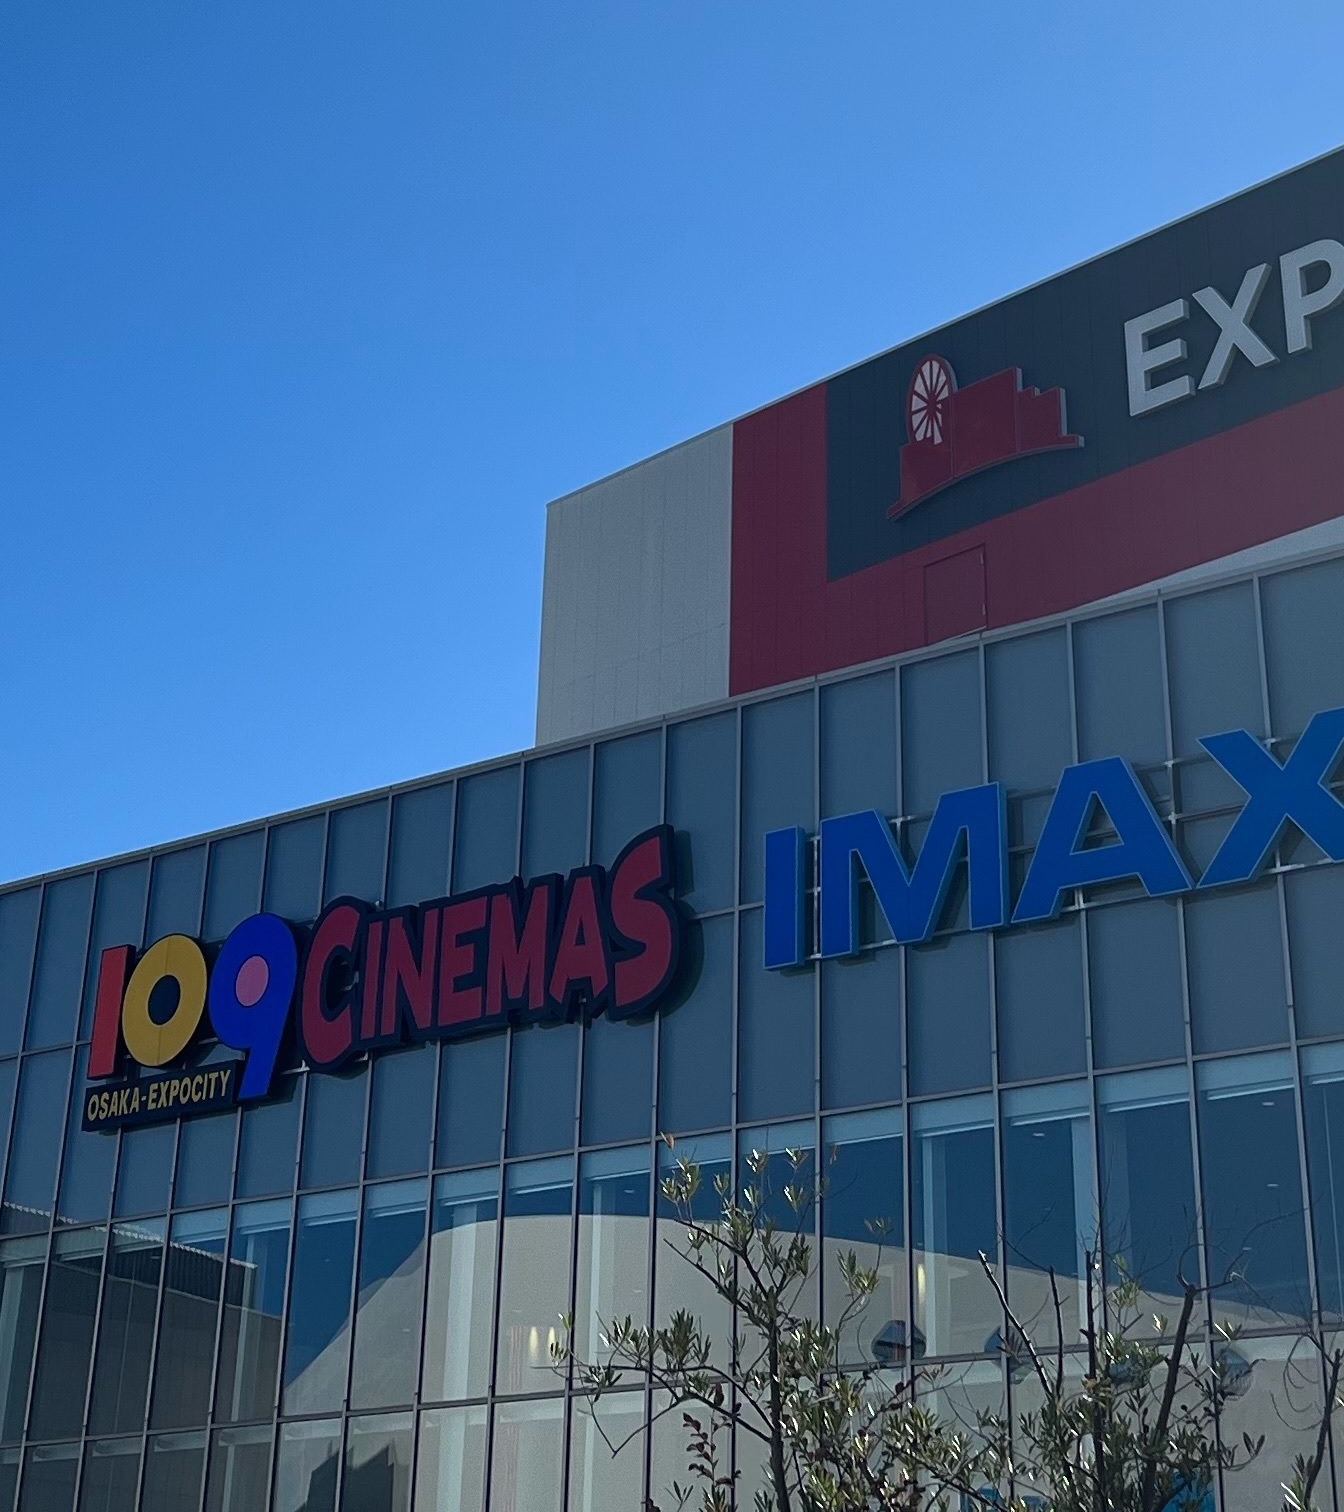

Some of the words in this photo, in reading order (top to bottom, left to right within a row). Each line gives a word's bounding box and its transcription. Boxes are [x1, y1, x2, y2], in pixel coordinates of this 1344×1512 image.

[87, 912, 299, 1102] 109
[302, 825, 676, 1072] CINEMAS
[86, 1069, 232, 1123] OSAKA-EXPOCITY
